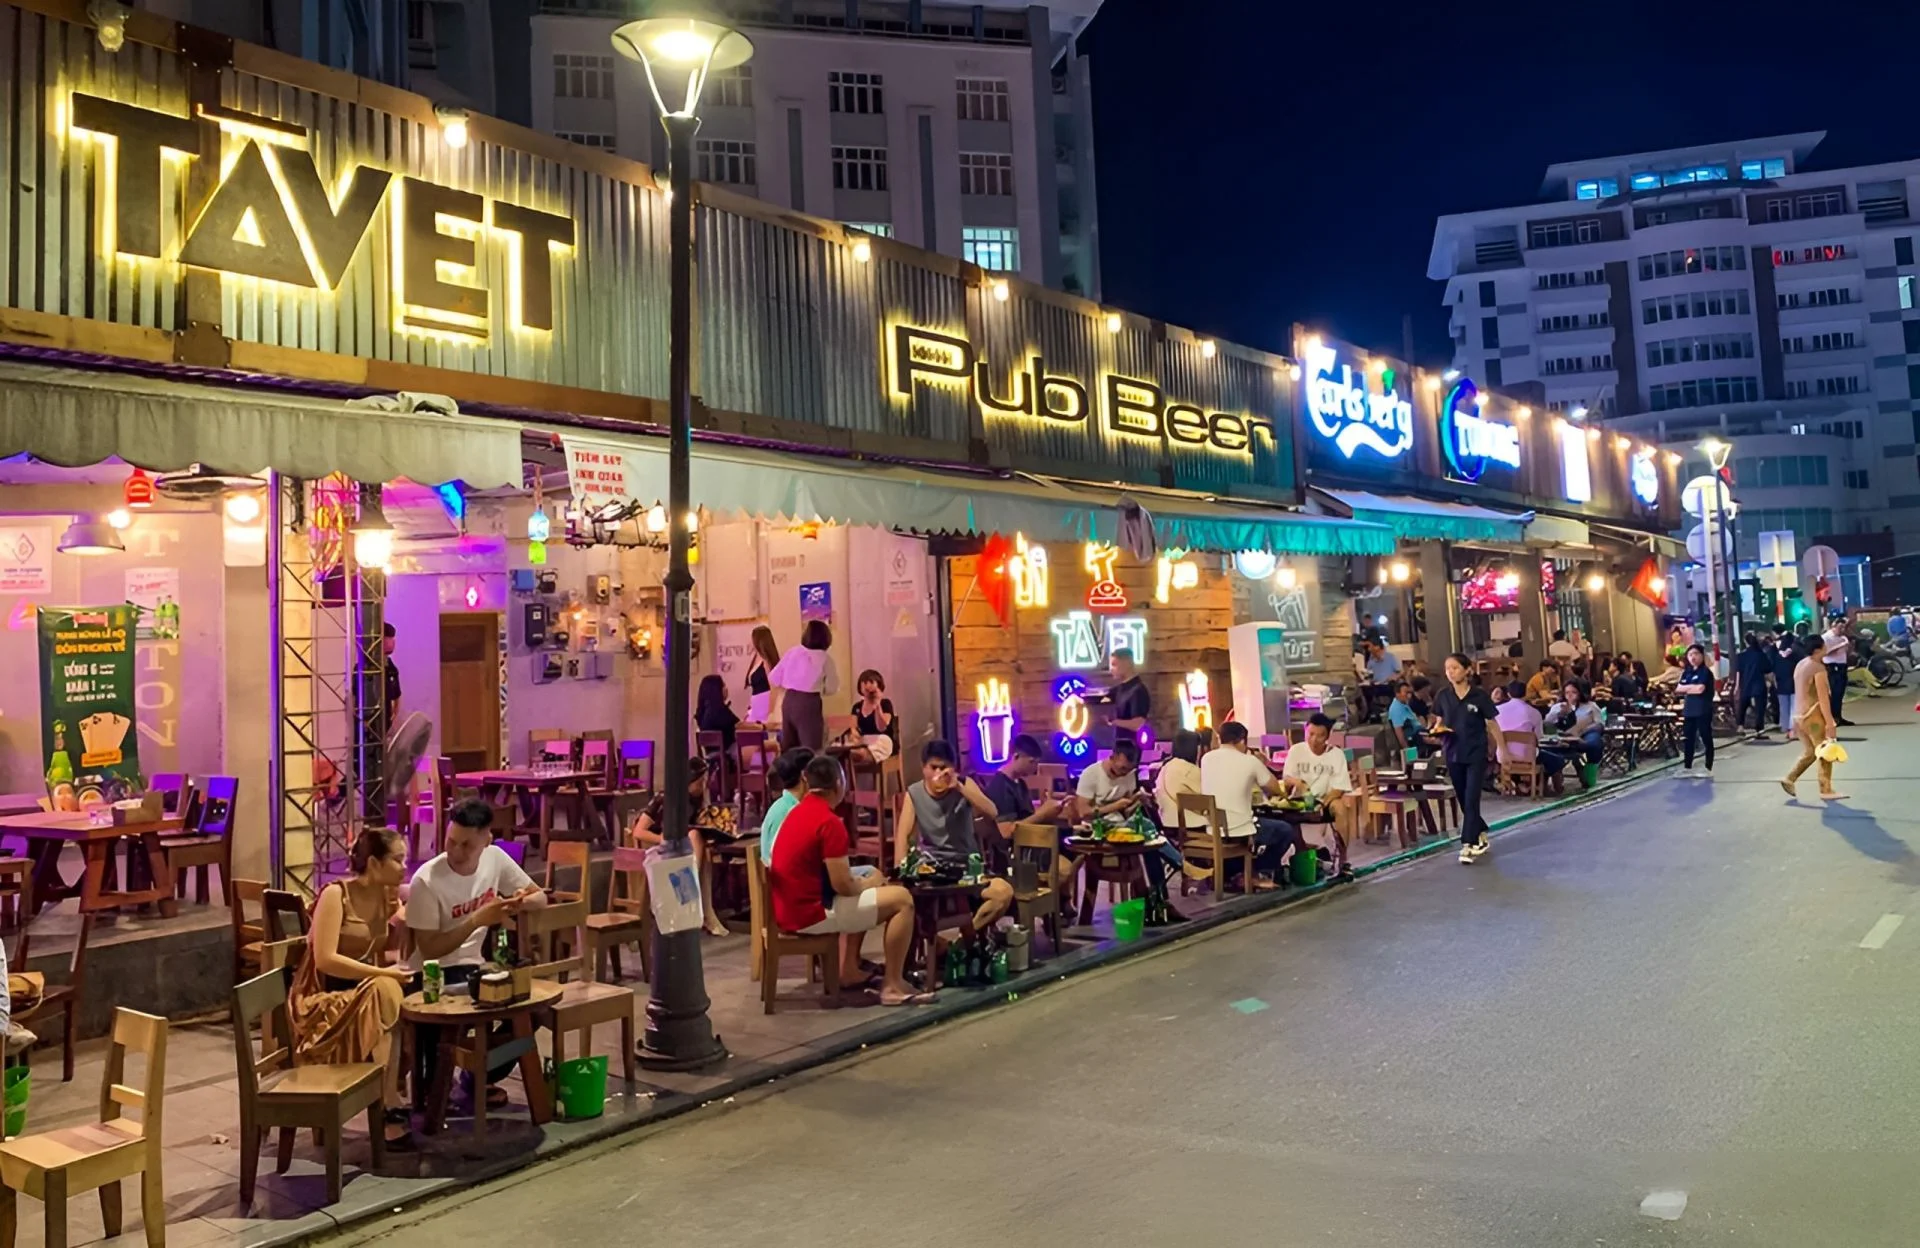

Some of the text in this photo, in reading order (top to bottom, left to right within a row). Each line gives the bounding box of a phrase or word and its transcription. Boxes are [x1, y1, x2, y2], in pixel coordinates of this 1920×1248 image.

[894, 324, 1277, 454] Pub Beer
[1454, 410, 1521, 467] TUG
